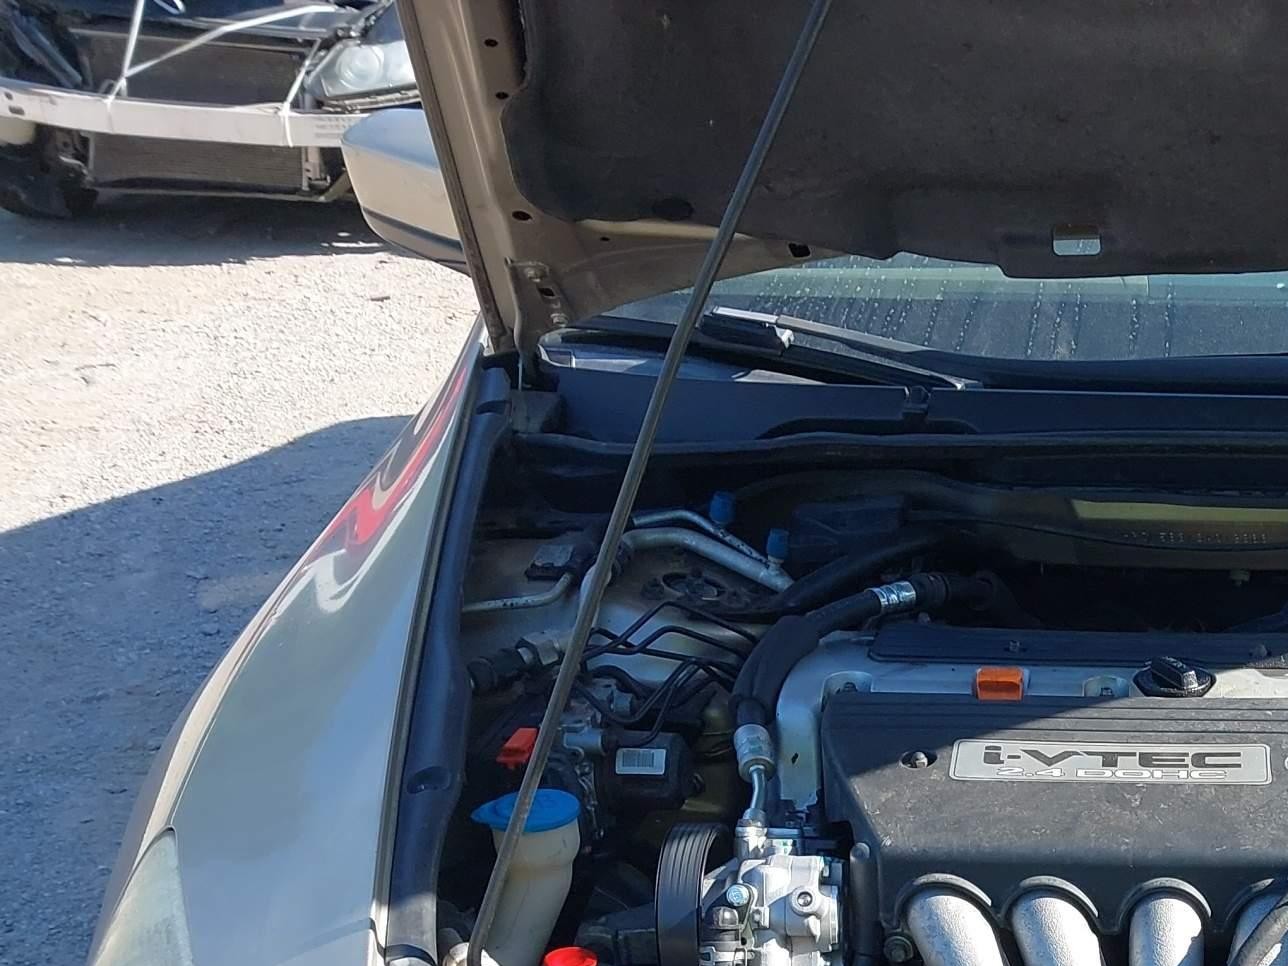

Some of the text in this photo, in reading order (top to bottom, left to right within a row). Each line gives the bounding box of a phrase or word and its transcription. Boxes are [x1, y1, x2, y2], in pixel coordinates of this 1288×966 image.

[984, 745, 1242, 768] i-VTEC
[996, 767, 1227, 780] 2.4 DOHC
